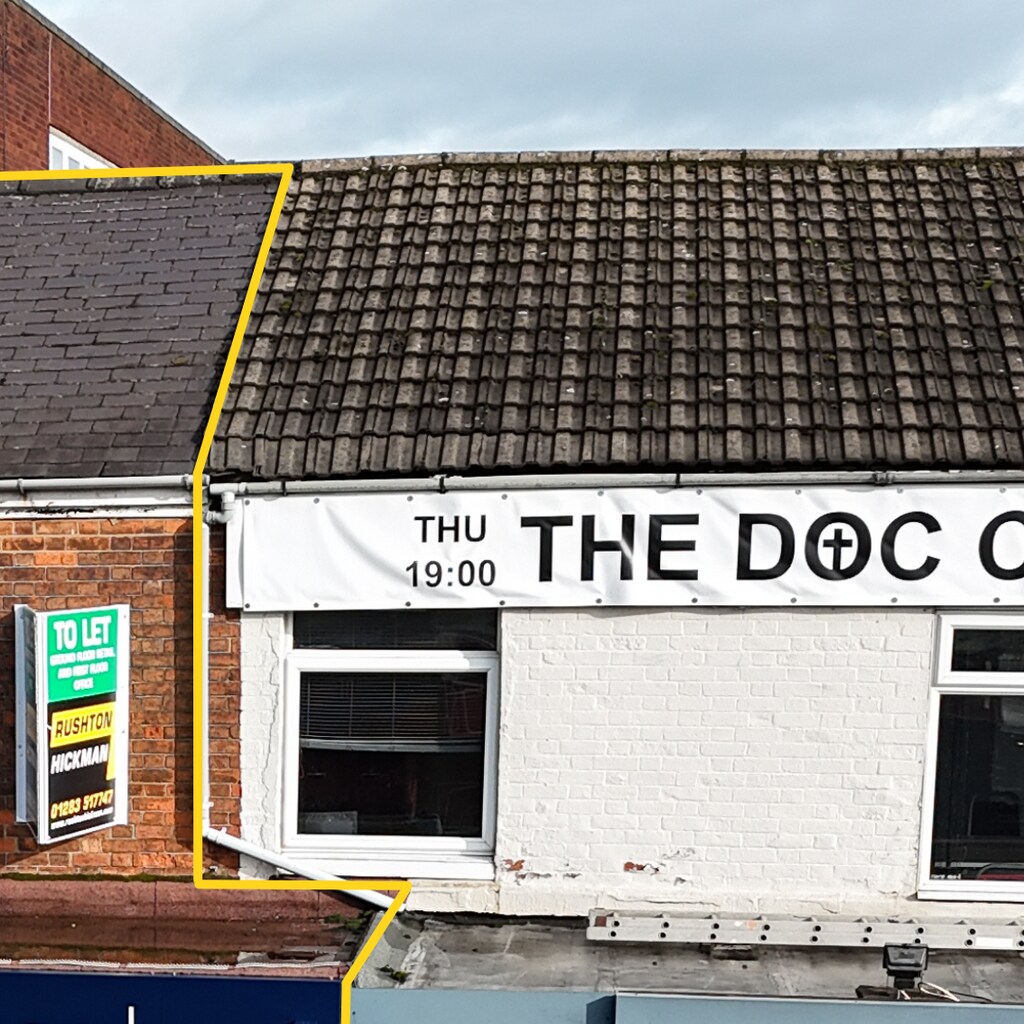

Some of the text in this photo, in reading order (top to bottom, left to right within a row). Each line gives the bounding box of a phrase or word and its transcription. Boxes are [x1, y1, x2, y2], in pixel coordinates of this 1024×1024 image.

[414, 514, 486, 543] THU
[520, 513, 700, 583] THE
[736, 511, 942, 582] DOC
[405, 559, 496, 588] 19:00
[53, 615, 112, 651] TO LET
[55, 711, 113, 738] RUSHTON
[50, 743, 109, 774] HICKMAN
[50, 797, 81, 819] 01283
[82, 789, 114, 811] 517747
